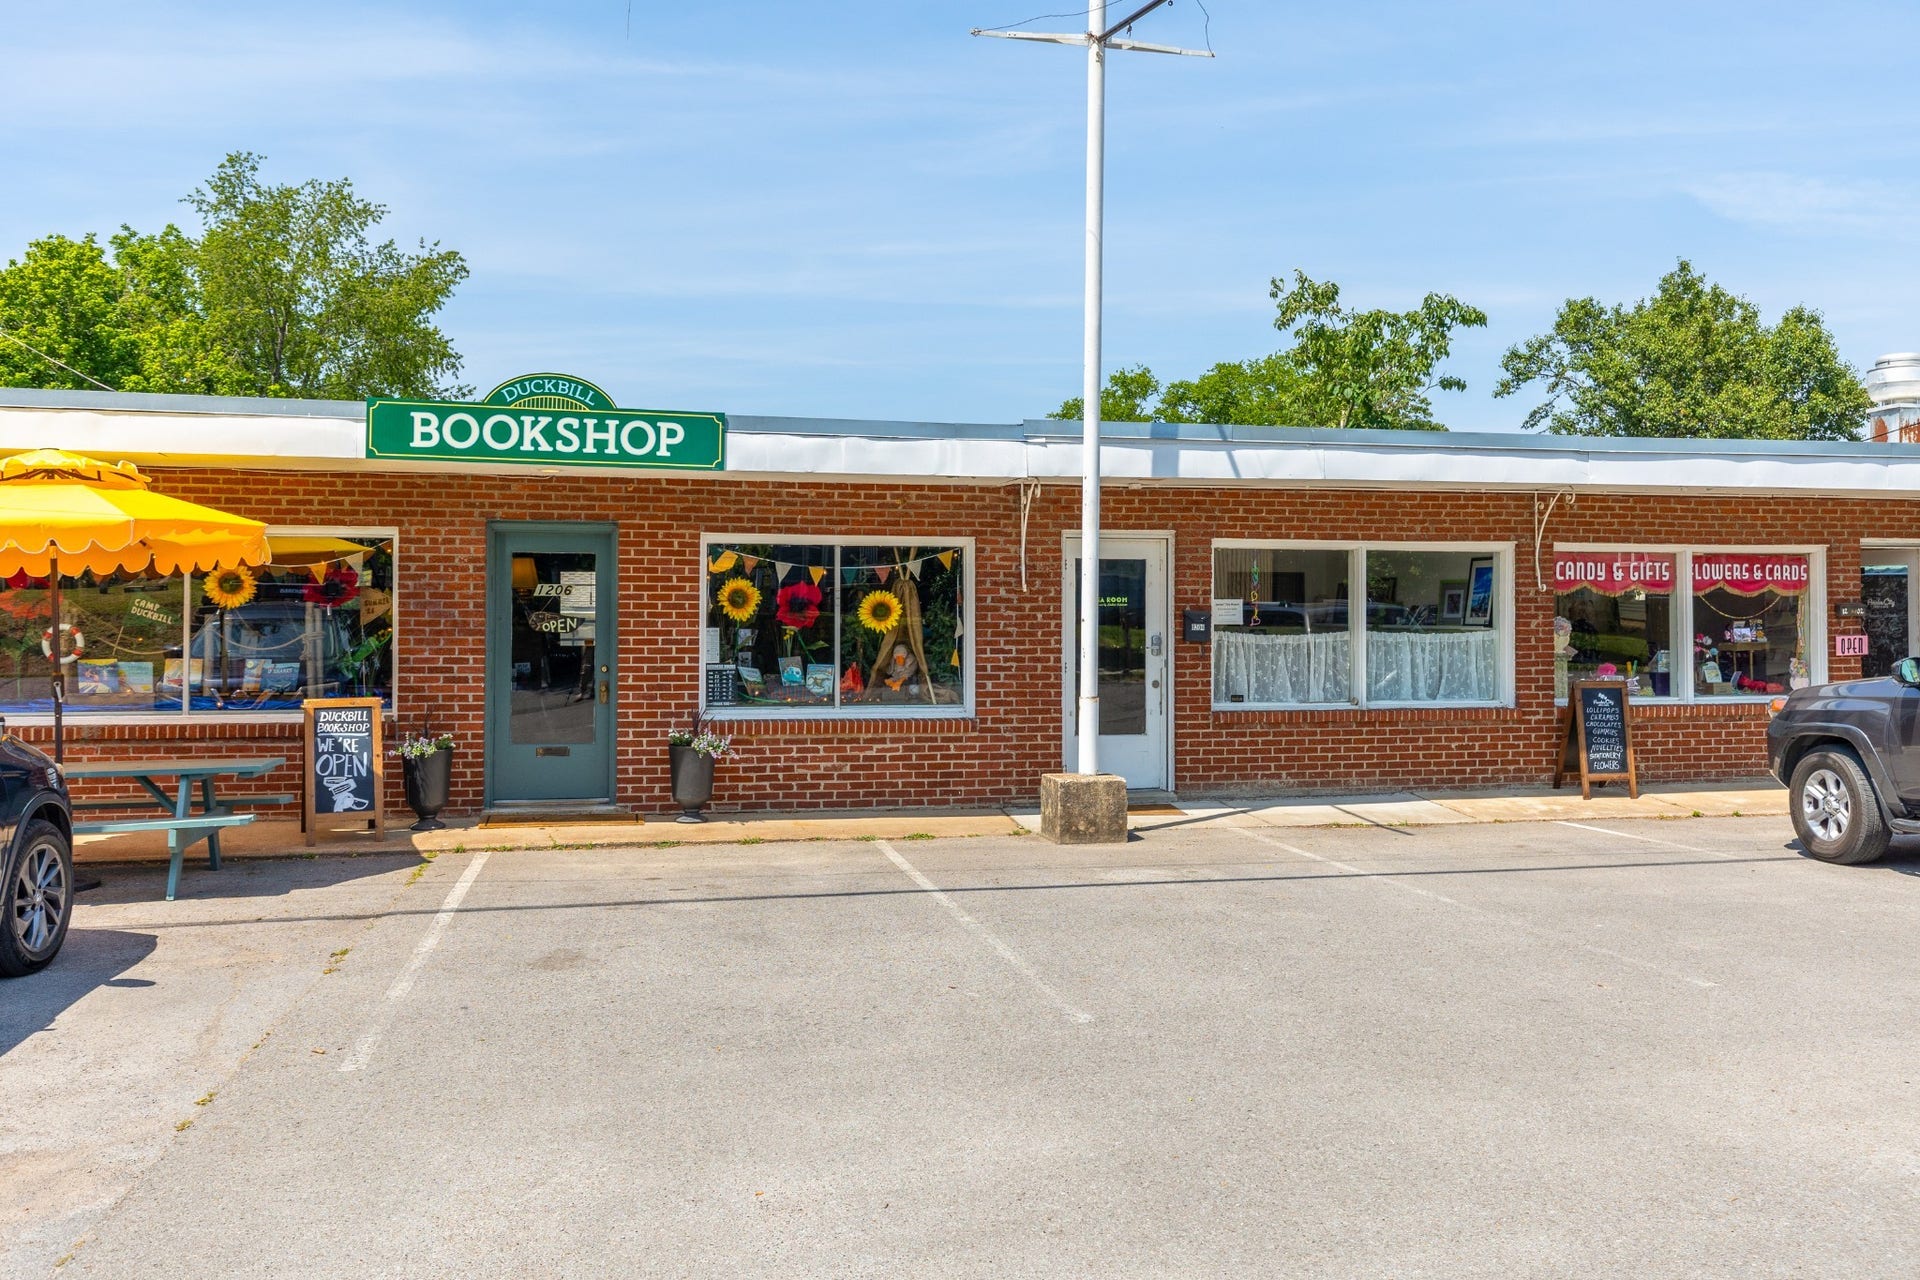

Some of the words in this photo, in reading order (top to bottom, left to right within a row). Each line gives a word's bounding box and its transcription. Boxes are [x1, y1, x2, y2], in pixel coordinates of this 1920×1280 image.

[501, 379, 596, 407] DUCKBILL
[409, 411, 685, 457] BOOKSHOP
[1555, 561, 1606, 582] CANDY
[1612, 562, 1625, 582] &
[1629, 562, 1670, 582] GIFTS
[1753, 563, 1763, 581] &
[1765, 563, 1808, 582] CARDS
[538, 585, 573, 596] 1206
[134, 598, 160, 610] CAMP
[131, 606, 172, 625] DUCKBILL
[542, 618, 578, 633] OPEN
[1840, 637, 1864, 655] OPEN
[320, 711, 369, 722] DUCKBILL
[1590, 713, 1620, 721] CARAMELS
[1585, 721, 1622, 729] CHOCOLATES
[1592, 728, 1619, 736] GUMMIES
[316, 737, 359, 753] WE'RE
[1592, 736, 1620, 745] COOKIES
[1590, 744, 1624, 753] NOVELTIES
[1589, 752, 1622, 760] STATIONERY
[315, 752, 368, 778] OPEN
[1593, 760, 1620, 770] FLOWERS
